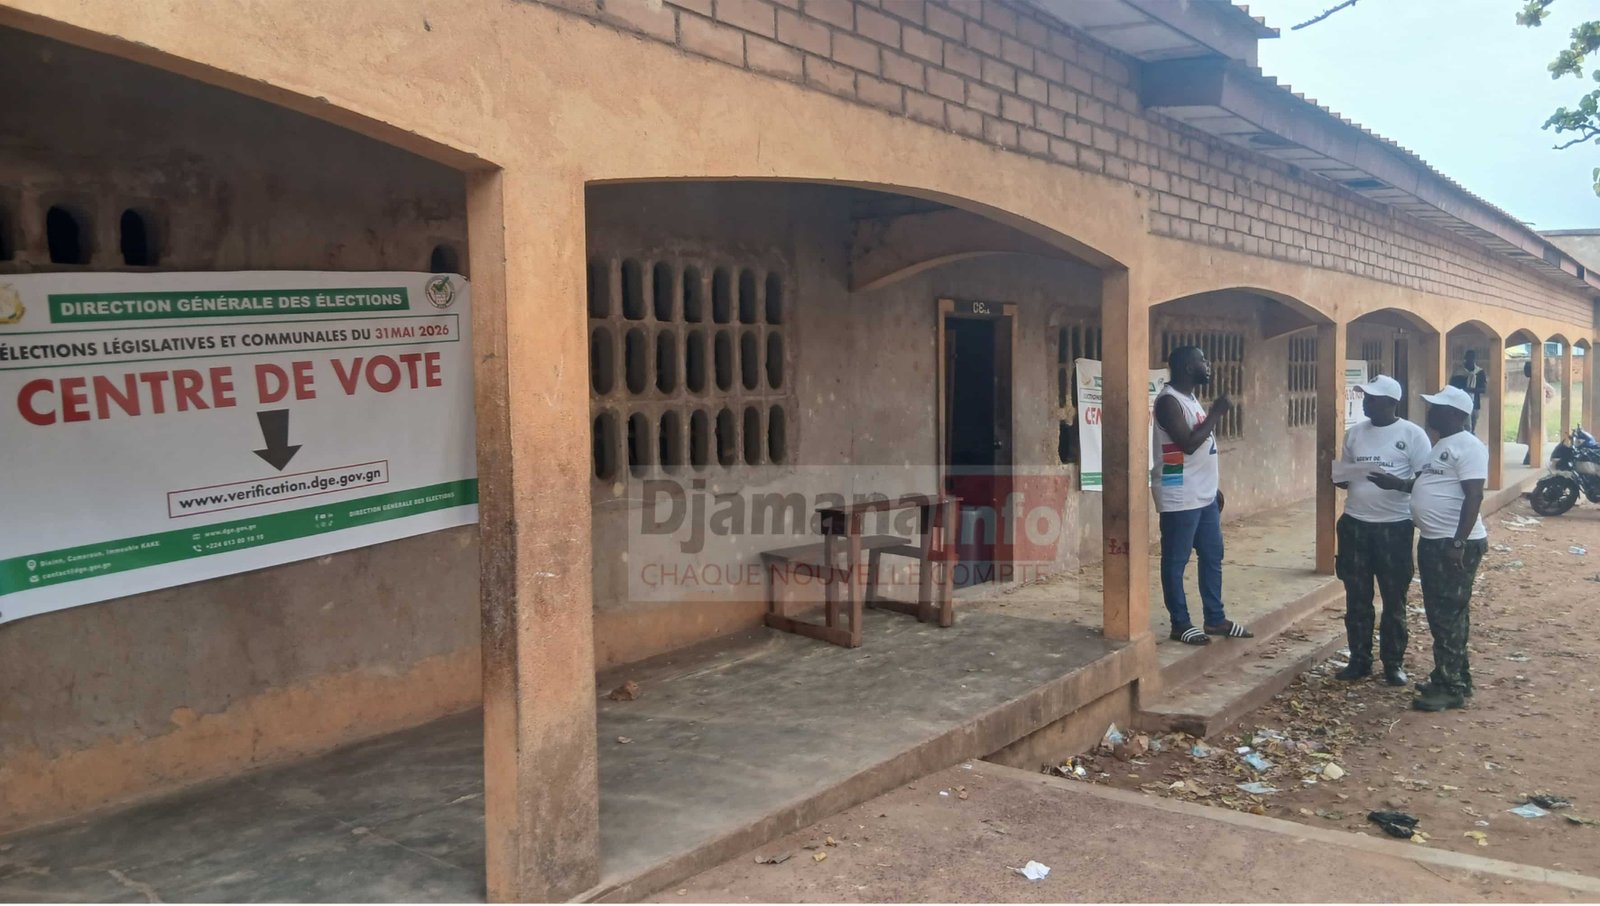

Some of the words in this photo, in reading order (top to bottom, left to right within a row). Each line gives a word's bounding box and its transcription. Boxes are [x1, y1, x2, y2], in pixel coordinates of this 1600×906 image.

[60, 300, 172, 316] DIRECTION
[177, 295, 273, 312] GÉNÉRALE
[279, 295, 311, 309] DES
[316, 293, 402, 308] ÉLECTIONS
[0, 342, 97, 361] ÉLECTIONS
[103, 335, 215, 355] LÉGISLATIVES
[221, 334, 236, 348] ET
[242, 329, 348, 347] COMMUNALES
[352, 328, 371, 341] DU
[419, 324, 449, 337] 2026
[17, 366, 237, 426] CENTRE
[255, 360, 316, 404] DE
[330, 352, 442, 396] VOTE
[179, 468, 381, 509] www.verification.dge.gov.gn
